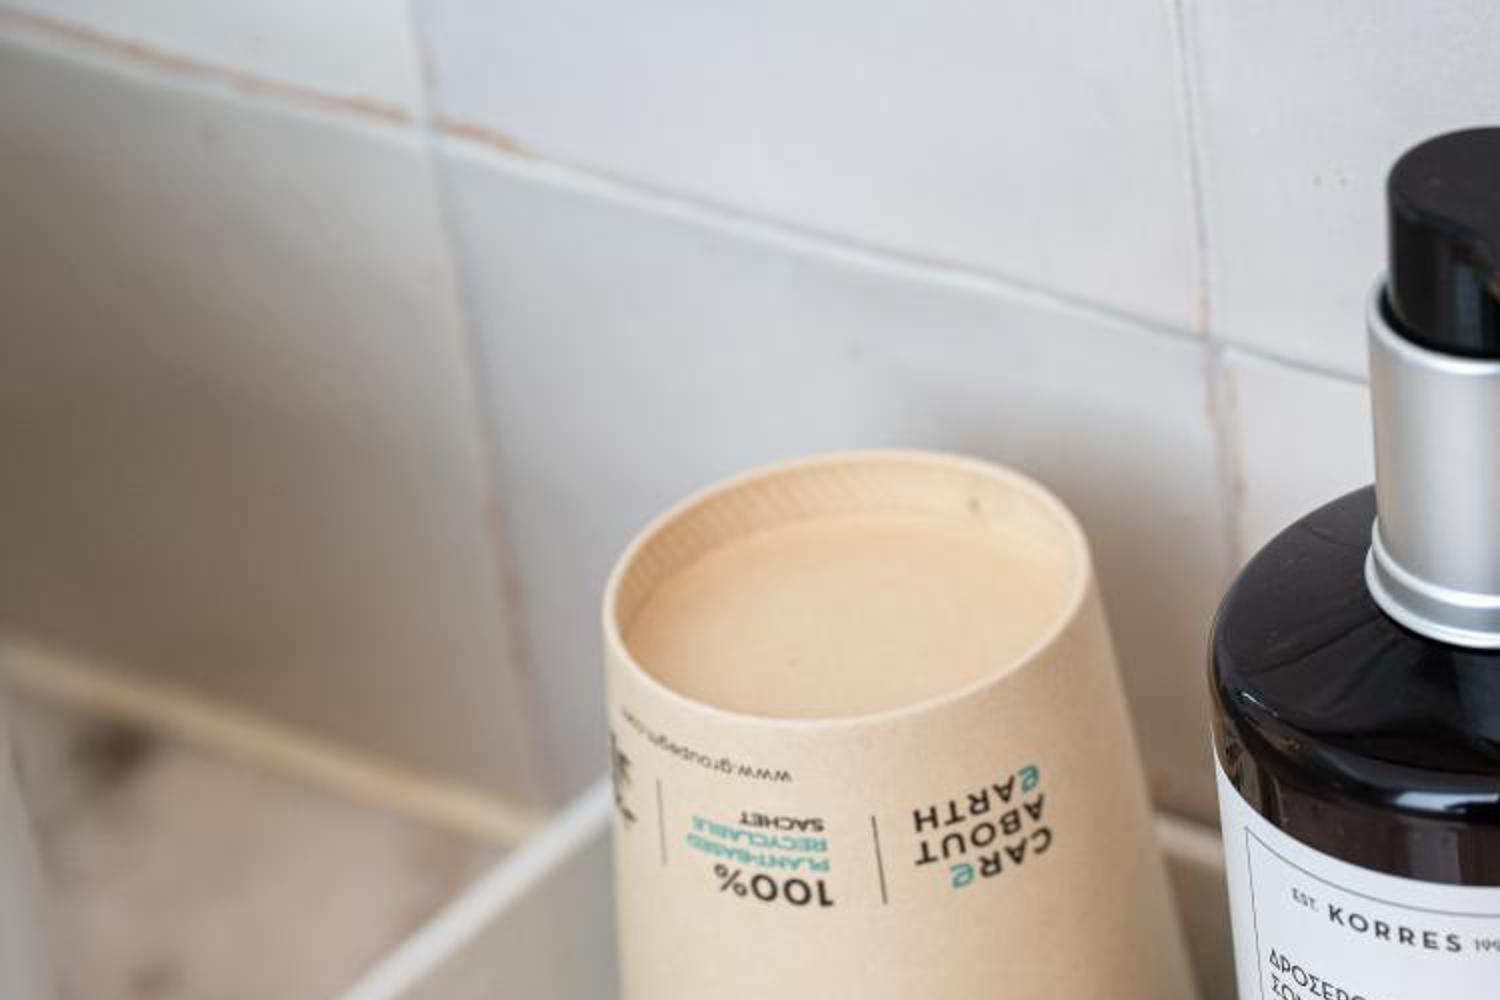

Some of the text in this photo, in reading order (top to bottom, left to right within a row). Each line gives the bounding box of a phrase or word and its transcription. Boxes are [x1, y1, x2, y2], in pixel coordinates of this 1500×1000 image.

[691, 815, 829, 853] RECYCLABLE
[739, 810, 826, 833] SACHET
[914, 793, 1048, 867] ABOUT
[684, 831, 832, 872] PLANT-BASED
[712, 863, 835, 908] 100%
[1290, 888, 1320, 912] EST.
[1327, 903, 1464, 954] KORRES
